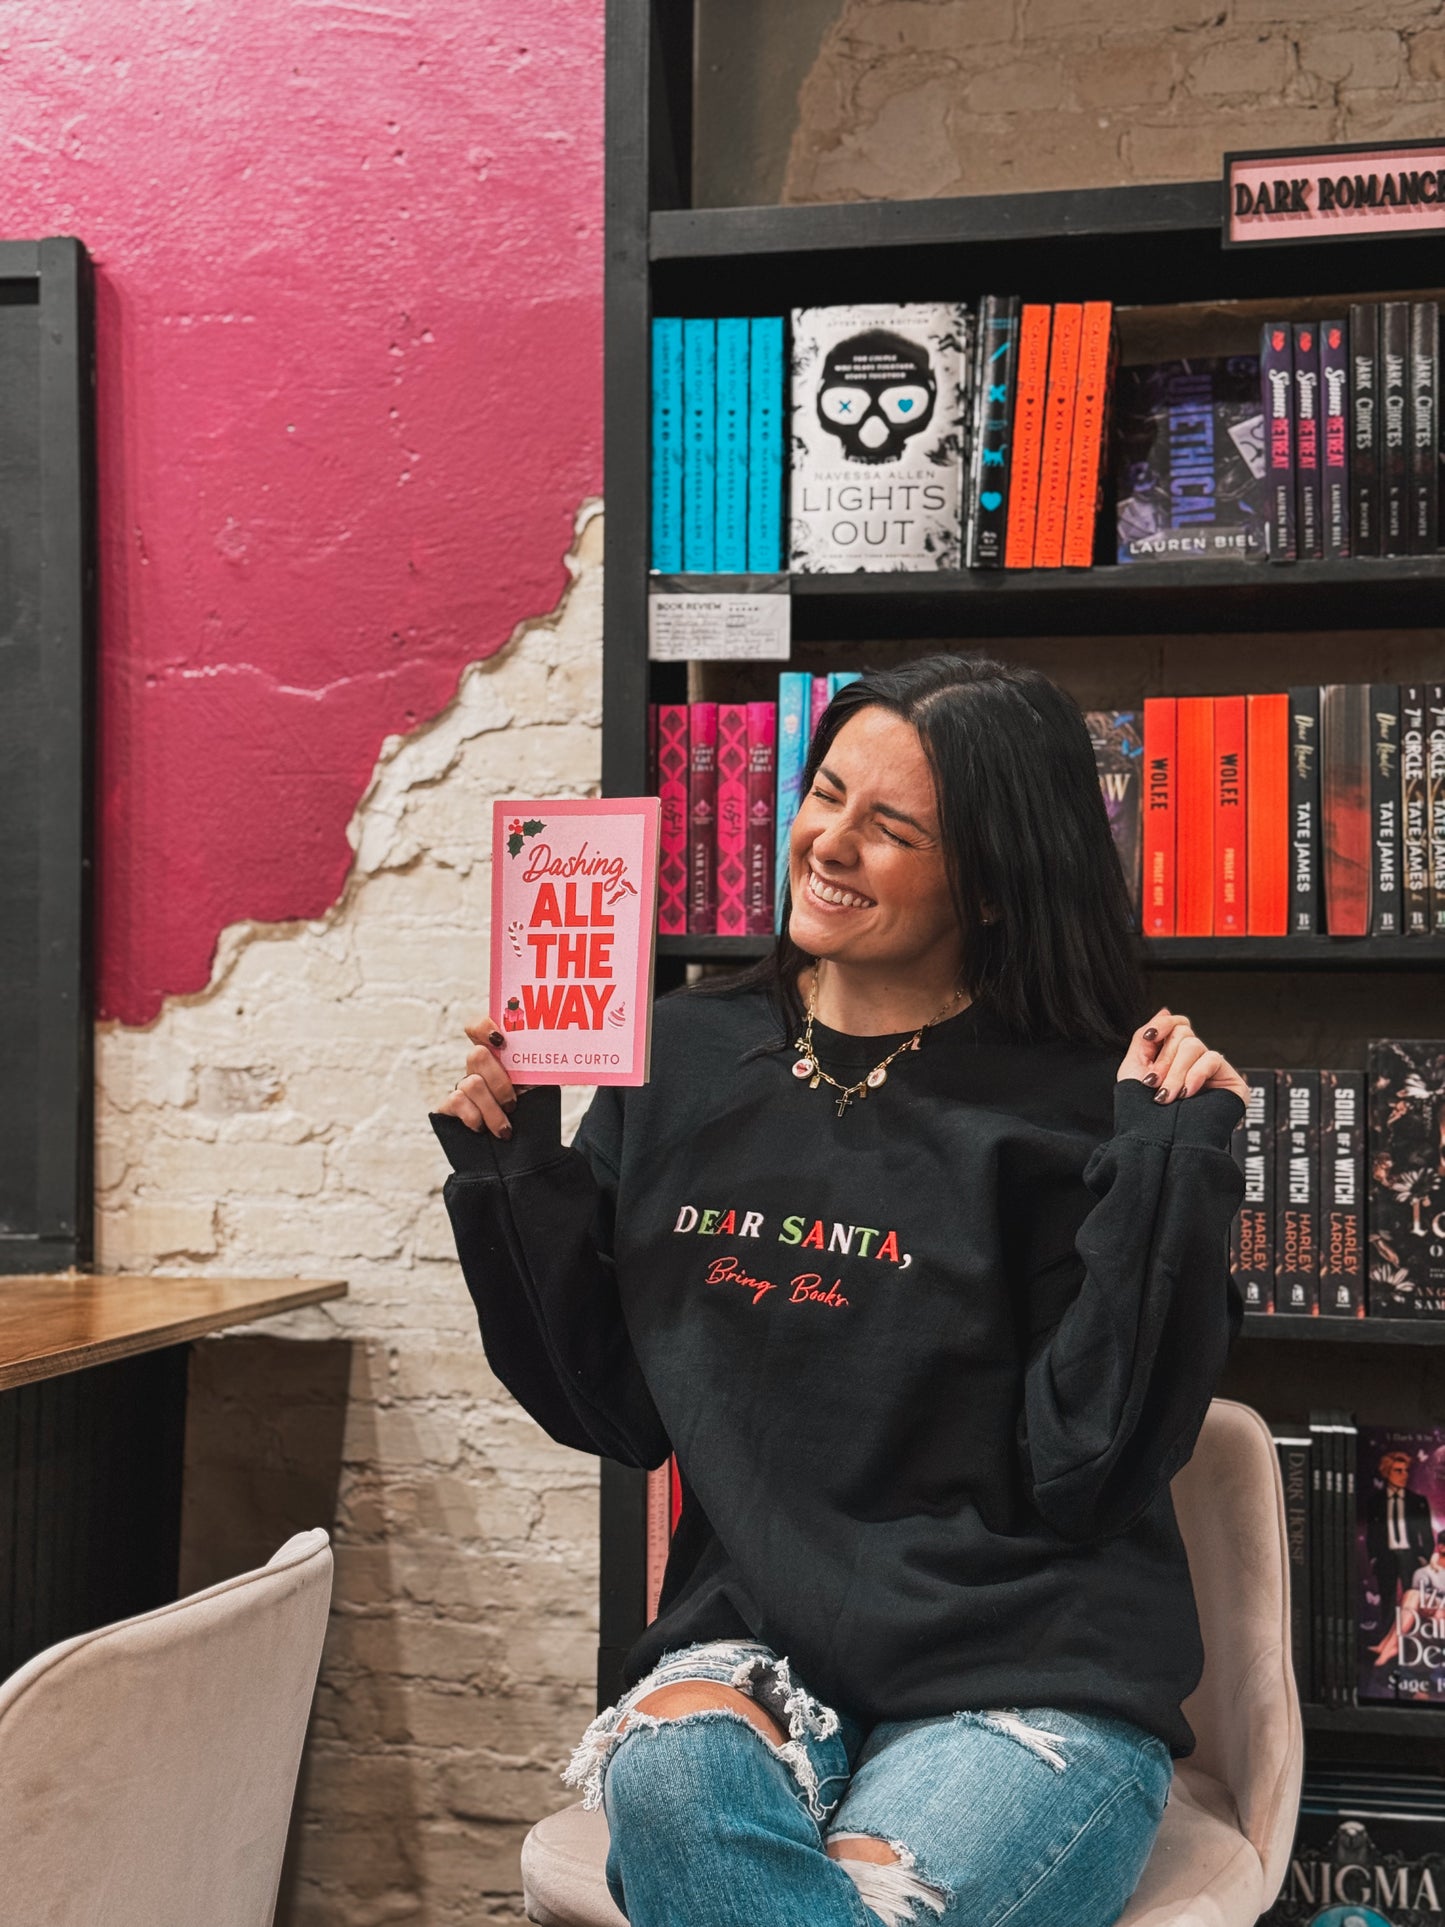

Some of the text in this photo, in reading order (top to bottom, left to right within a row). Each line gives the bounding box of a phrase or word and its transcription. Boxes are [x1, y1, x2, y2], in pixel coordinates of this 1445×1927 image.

[1235, 169, 1445, 215] DARK ROMANCE
[1271, 418, 1289, 469] RETREAT
[1327, 416, 1344, 467] RETREAT
[1355, 397, 1373, 449] CHOICES
[1386, 395, 1404, 447] CHOICES
[1415, 396, 1432, 447] CHOICES
[814, 470, 935, 481] NAVESSA ALLEN
[1168, 374, 1216, 529] UNETHICAL
[803, 484, 946, 512] LIGHTS
[1277, 485, 1288, 548] LAUREN BIEL
[1304, 486, 1314, 548] LAUREN BIEL
[1331, 484, 1341, 546] LAUREN BIEL
[832, 520, 914, 546] OUT
[1130, 534, 1259, 554] LAUREN BIEL
[1404, 730, 1423, 780] CIRCLE
[1430, 729, 1445, 779] CIRCLE
[522, 841, 628, 892] Dashing
[1293, 802, 1310, 892] TATE JAMES
[1376, 801, 1394, 892] TATE JAMES
[1404, 800, 1424, 890] TATE JAMES
[1430, 799, 1445, 890] TATE JAMES
[528, 882, 615, 927] ALL
[526, 933, 615, 979] THE
[521, 984, 617, 1031] WAY
[512, 1052, 620, 1066] CHELSEA CURTO
[1245, 1086, 1265, 1128] SOUL
[1248, 1130, 1261, 1145] OF
[1289, 1088, 1310, 1204] SOUL OF A WITCH
[1334, 1088, 1355, 1205] SOUL OF A WITCH
[1245, 1155, 1265, 1202] WITCH
[674, 1205, 912, 1270] DEAR SANTA,
[1240, 1210, 1252, 1271] LAROUX
[1254, 1212, 1268, 1272] HARLEY
[1285, 1211, 1297, 1273] LAROUX
[1298, 1214, 1312, 1274] HARLEY
[1330, 1212, 1342, 1274] LAROUX
[1344, 1215, 1358, 1275] HARLEY
[704, 1256, 849, 1307] Bring Books
[1286, 1453, 1306, 1500] DARK
[1278, 1859, 1442, 1912] NIGMA
